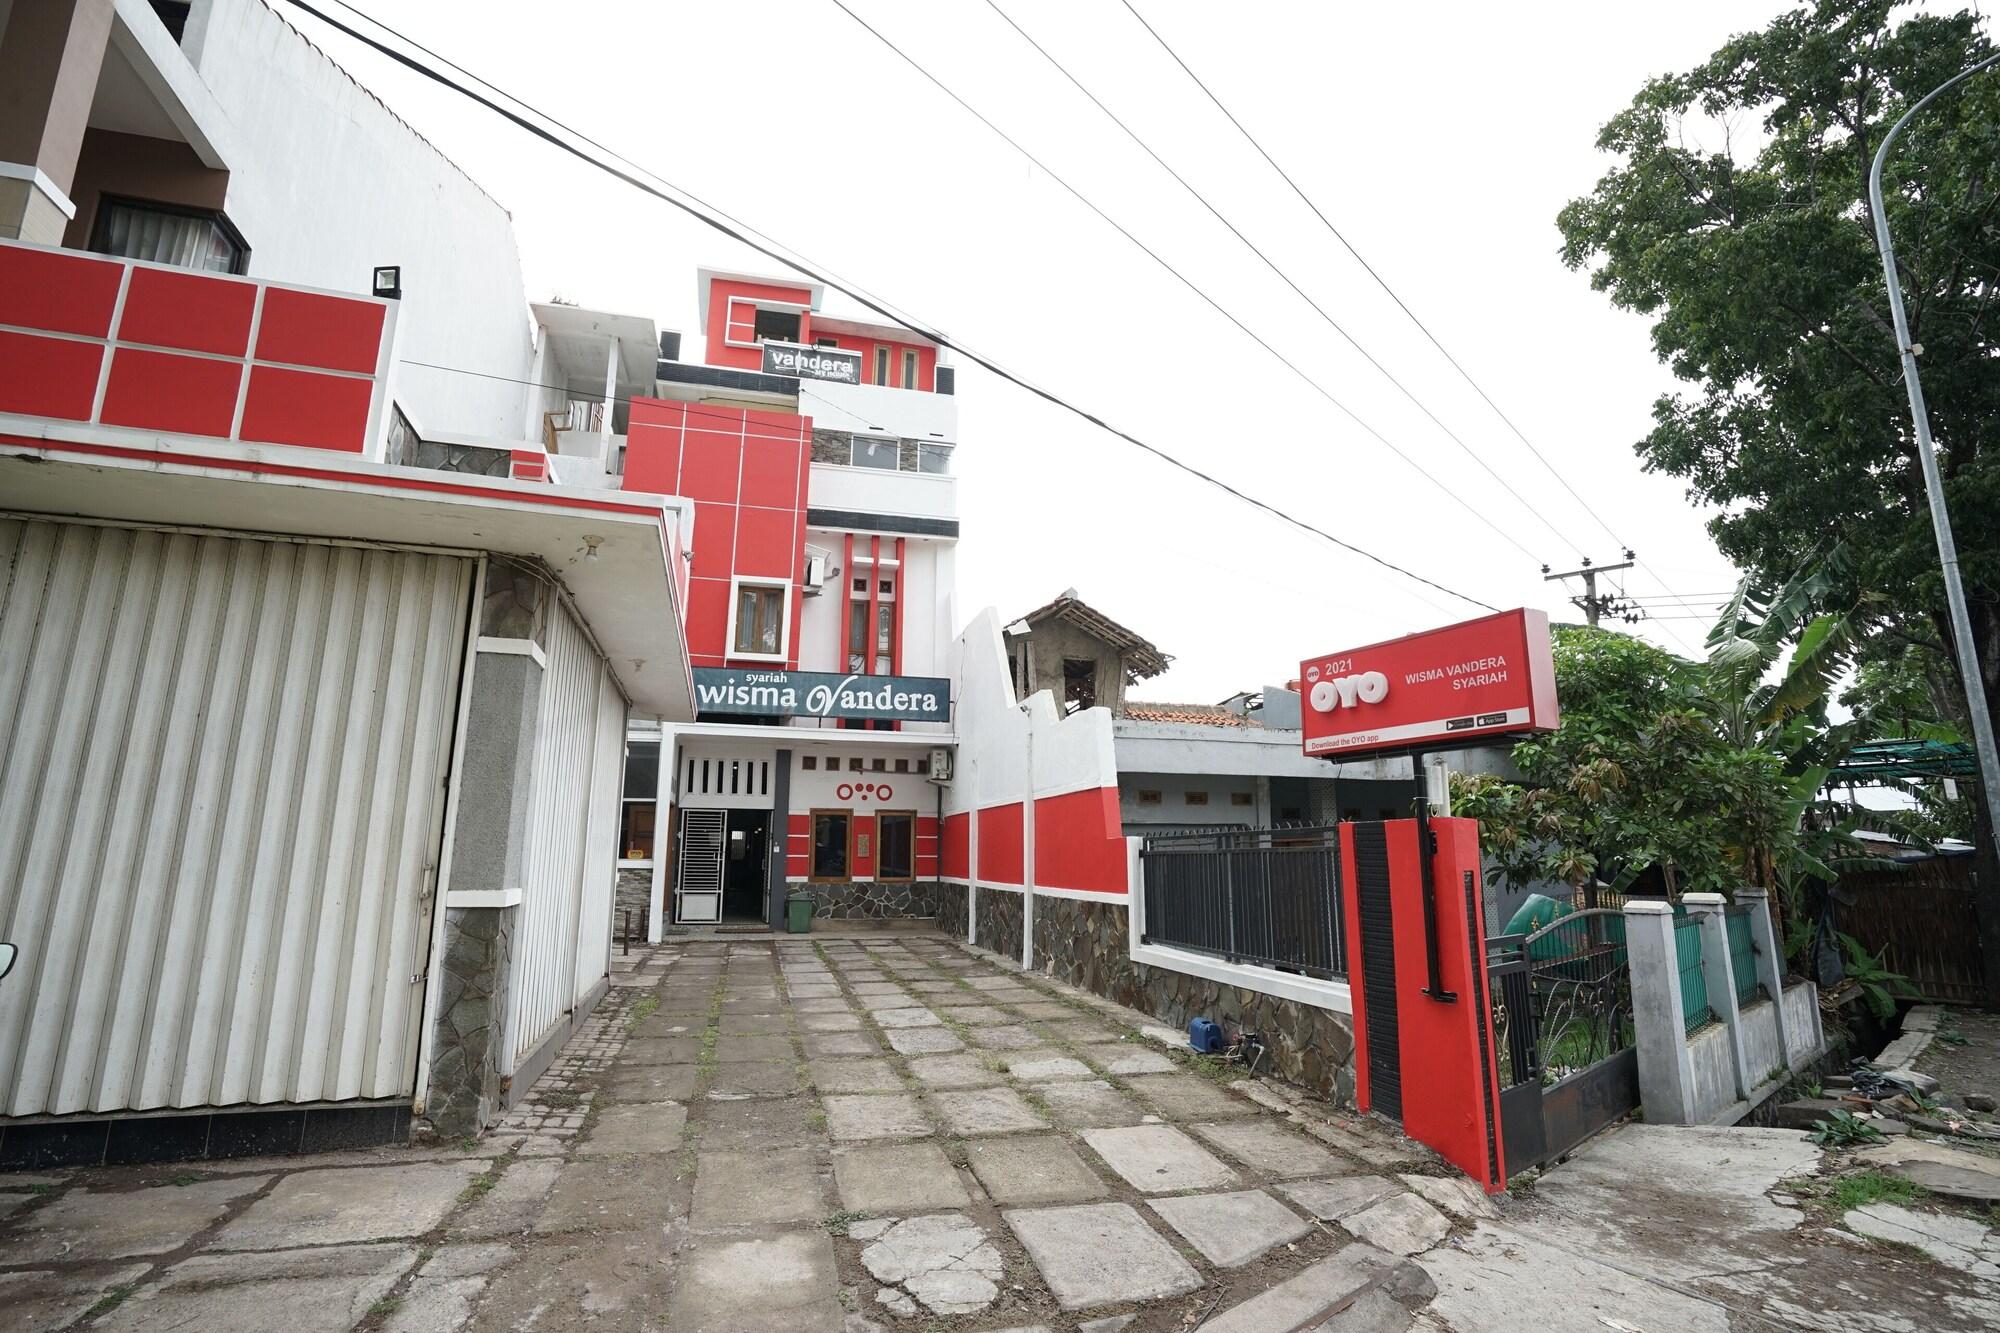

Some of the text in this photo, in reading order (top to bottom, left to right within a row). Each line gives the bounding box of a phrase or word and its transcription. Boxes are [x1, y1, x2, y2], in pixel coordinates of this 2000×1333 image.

[1325, 658, 1352, 675] 2021
[1405, 655, 1506, 684] WISMA VANDERA
[745, 673, 787, 685] syariah
[1453, 671, 1507, 690] SYARIAH
[698, 678, 797, 707] wisma
[1310, 671, 1389, 712] OYO
[1311, 735, 1379, 750] Download the OYO app
